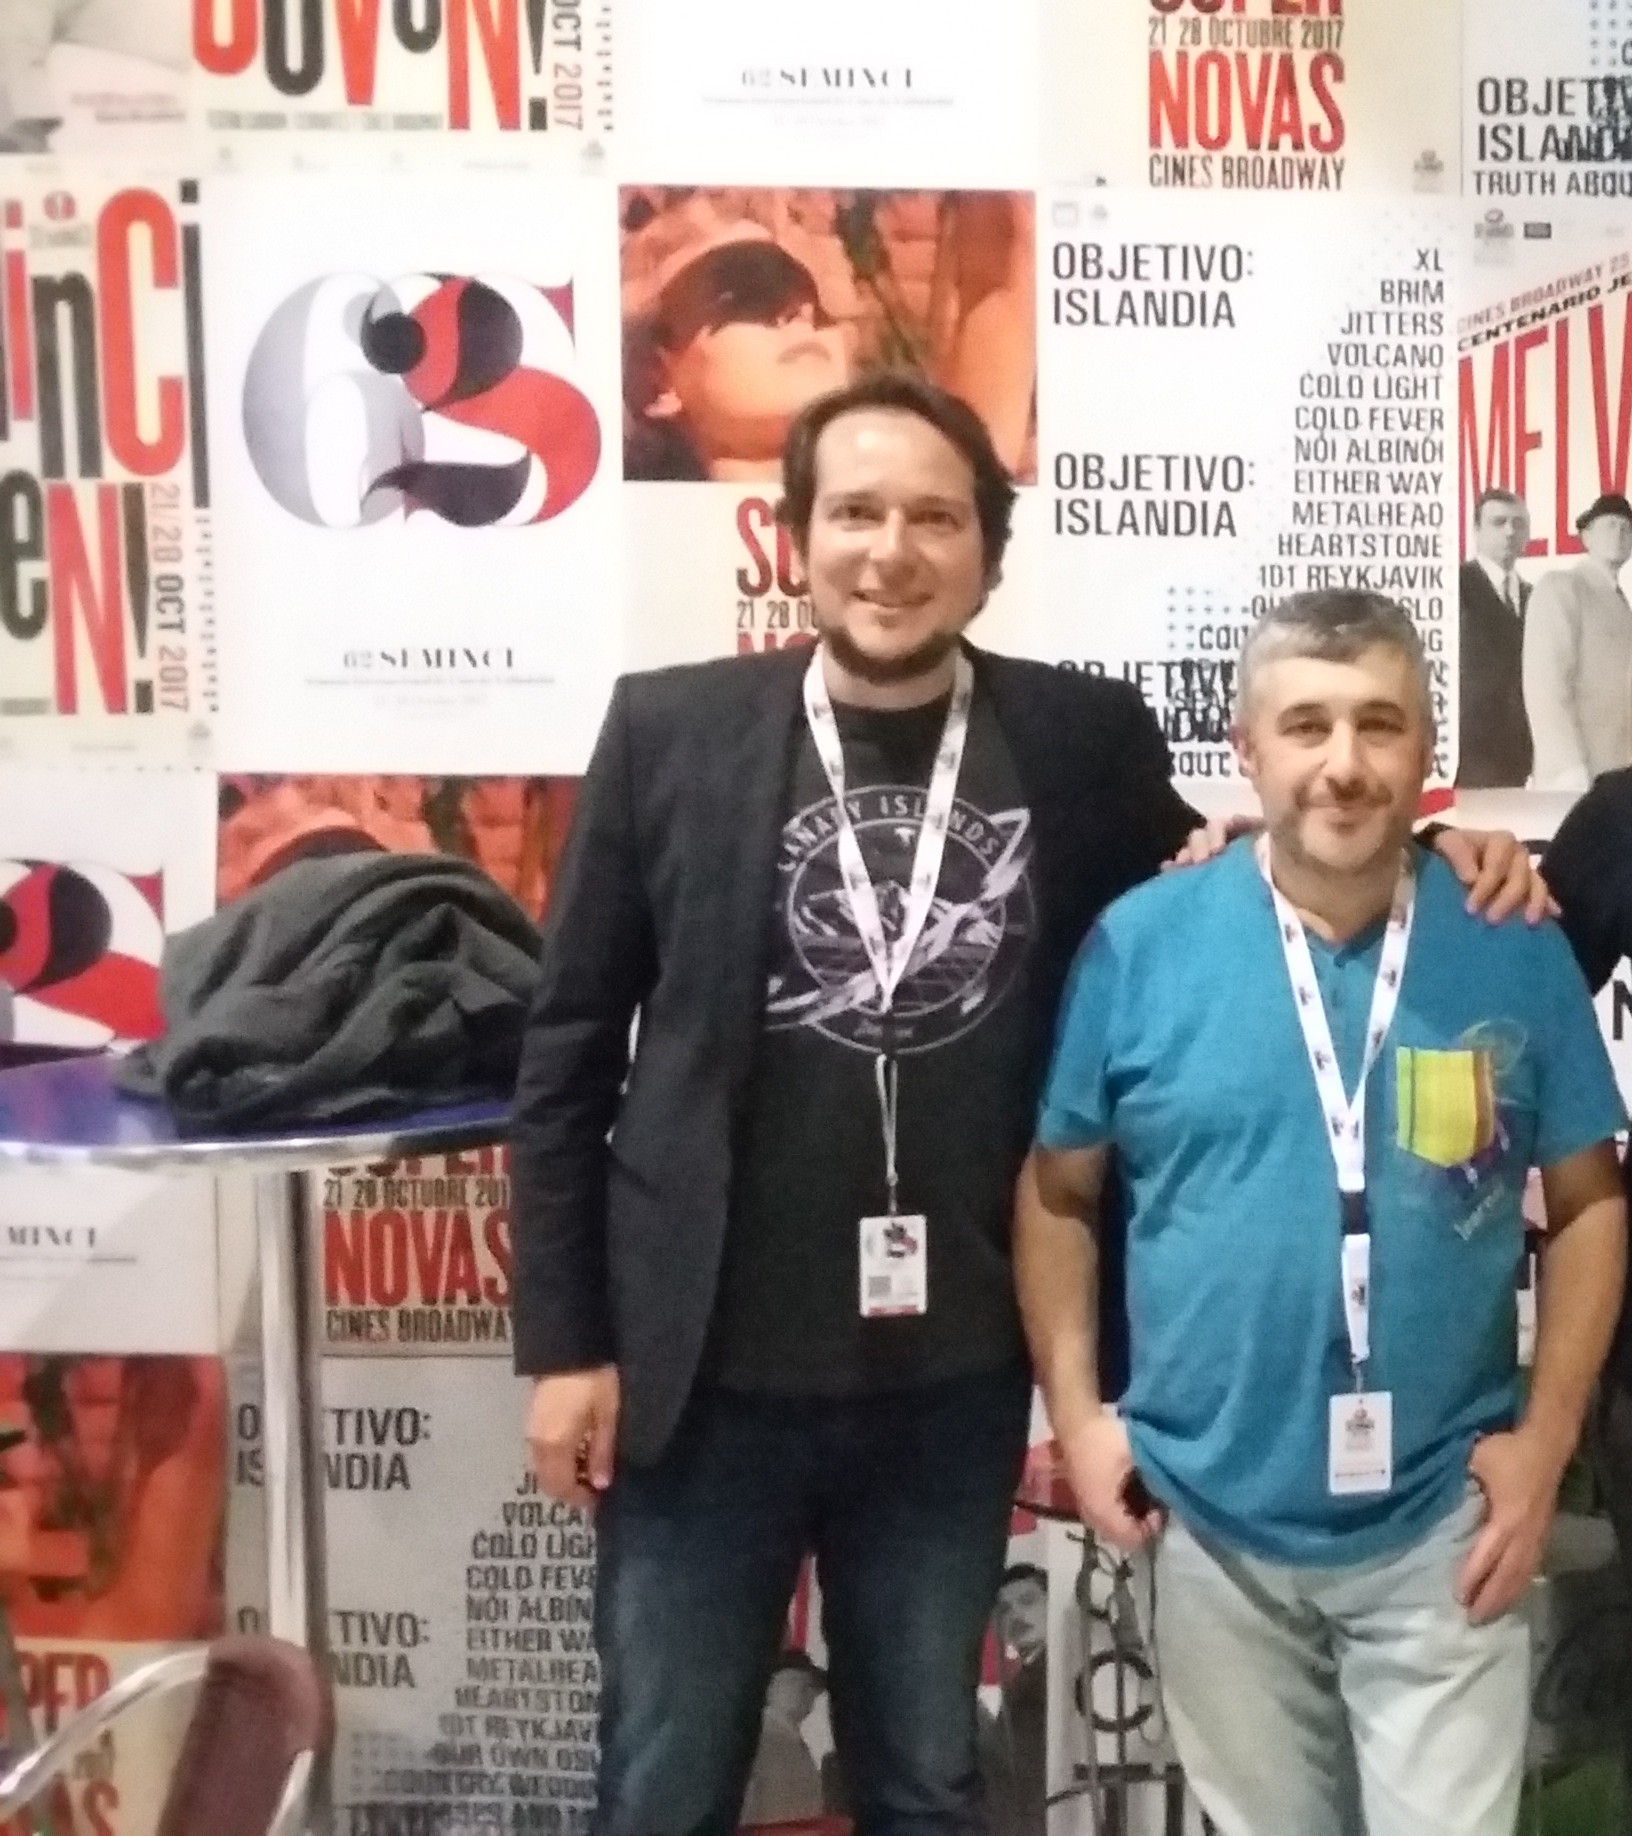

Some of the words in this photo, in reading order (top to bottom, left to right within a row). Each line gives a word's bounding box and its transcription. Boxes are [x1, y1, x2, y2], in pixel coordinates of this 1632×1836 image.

[1208, 17, 1293, 48] OCTUBRE
[1300, 19, 1343, 48] 2017
[1149, 51, 1344, 152] NOVAS
[1149, 155, 1213, 188] CINES
[1221, 156, 1344, 190] BROADWAY
[1474, 170, 1556, 197] TRUTH
[1052, 242, 1255, 283] OBJETIVO:
[1414, 248, 1444, 272] XL
[1380, 278, 1444, 304] BRIM
[1052, 289, 1237, 329] ISLANDIA
[1340, 310, 1444, 337] JITTERS
[1457, 286, 1602, 352] CENTENARIO
[1326, 342, 1444, 369] VOLCANO
[1299, 372, 1364, 399] COLD
[1373, 373, 1443, 400] LIGHT
[1295, 405, 1360, 431] COLD
[1368, 406, 1444, 432] FEVER
[1053, 452, 1256, 493] OBJETIVO:
[1293, 468, 1381, 495] EITHER
[1386, 470, 1444, 495] WAY
[1053, 499, 1238, 538] ISLANDIA
[1292, 500, 1444, 528] METALHEAD
[1278, 532, 1443, 559] HEARTSTONE
[1306, 564, 1444, 590] REYKJAVIK
[154, 573, 187, 635] OCT
[157, 644, 191, 714] 2017
[323, 1208, 513, 1308] NOVAS
